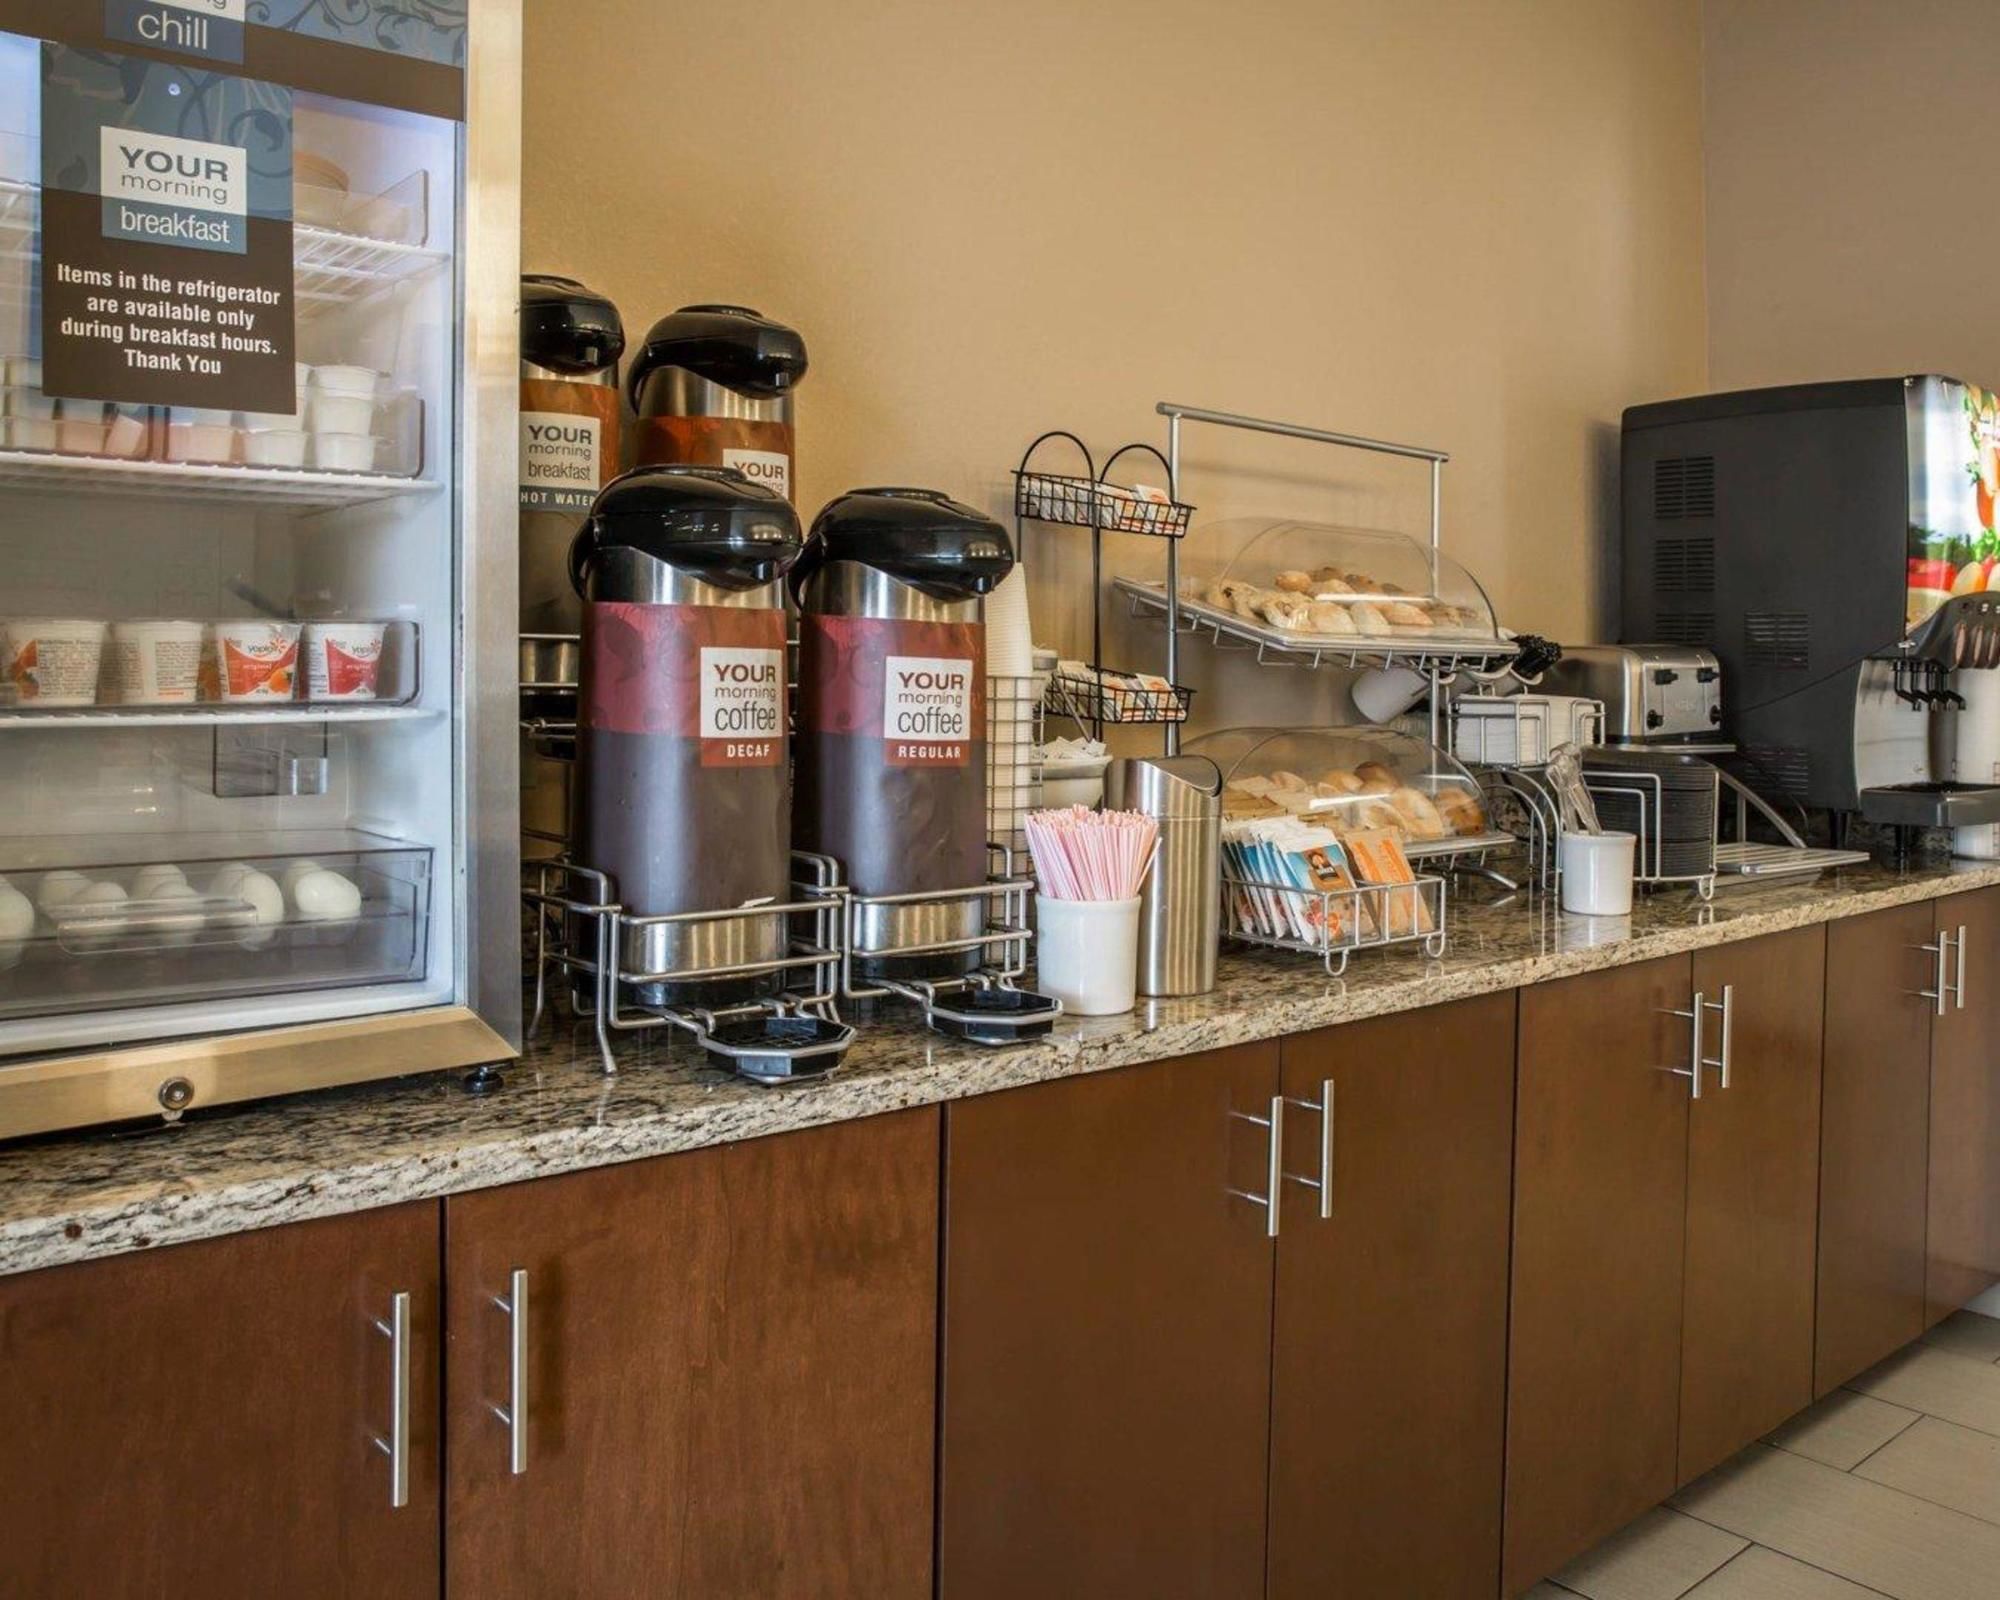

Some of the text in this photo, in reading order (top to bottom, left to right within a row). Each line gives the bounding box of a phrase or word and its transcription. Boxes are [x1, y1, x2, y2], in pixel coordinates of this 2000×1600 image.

[138, 10, 207, 50] chill
[119, 145, 229, 182] YOUR
[121, 174, 228, 205] morning
[121, 205, 231, 244] breakfast
[57, 263, 281, 305] Items in the refrigerator
[87, 297, 255, 331] are available only
[61, 318, 278, 355] during breakfast hours.
[124, 349, 222, 375] Thank You
[528, 425, 592, 445] YOUR
[528, 444, 592, 461] morning
[528, 460, 591, 481] breakfast
[733, 461, 784, 480] YOUR
[520, 492, 547, 503] HOT
[713, 664, 776, 682] YOUR
[898, 671, 964, 690] YOUR
[714, 687, 776, 702] morning
[898, 692, 963, 708] morning
[714, 701, 776, 731] coffee
[897, 706, 963, 734] coffee
[726, 744, 770, 758] DECAF
[898, 745, 961, 758] REGULAR
